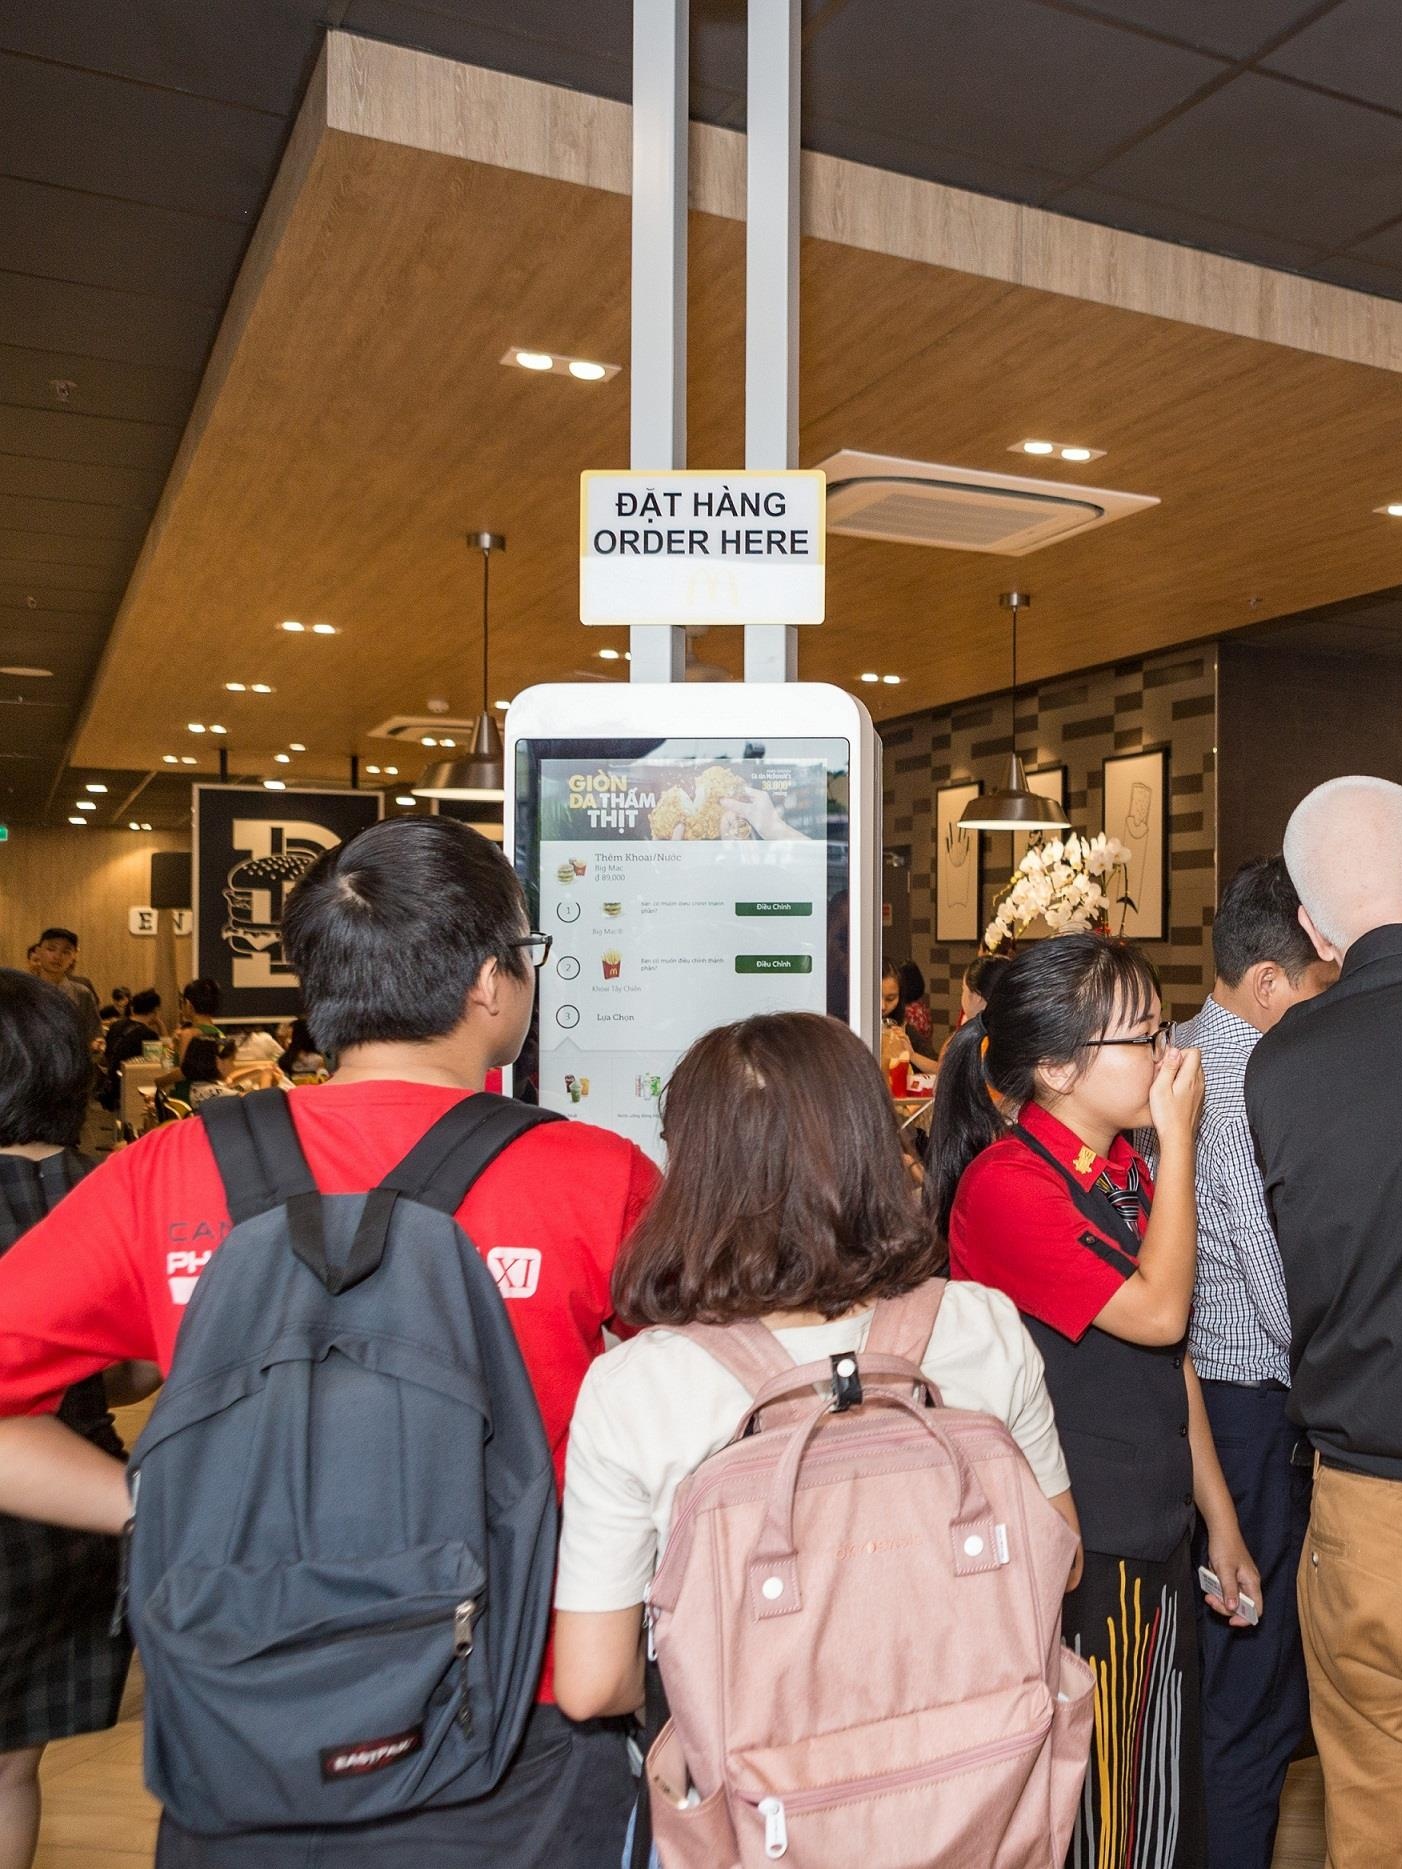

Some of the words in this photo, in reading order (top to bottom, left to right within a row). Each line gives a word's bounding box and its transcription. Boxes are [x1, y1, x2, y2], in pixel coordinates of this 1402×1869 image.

[615, 487, 682, 523] ĐẶT
[693, 485, 786, 517] HÀNG
[593, 529, 710, 555] ORDER
[721, 529, 809, 555] HERE
[568, 769, 628, 792] GIÒN
[569, 793, 597, 809] DA
[599, 787, 656, 809] THẤM
[587, 809, 639, 834] THỊT
[566, 906, 571, 915] 1
[565, 963, 571, 972] 2
[565, 1012, 571, 1021] 3
